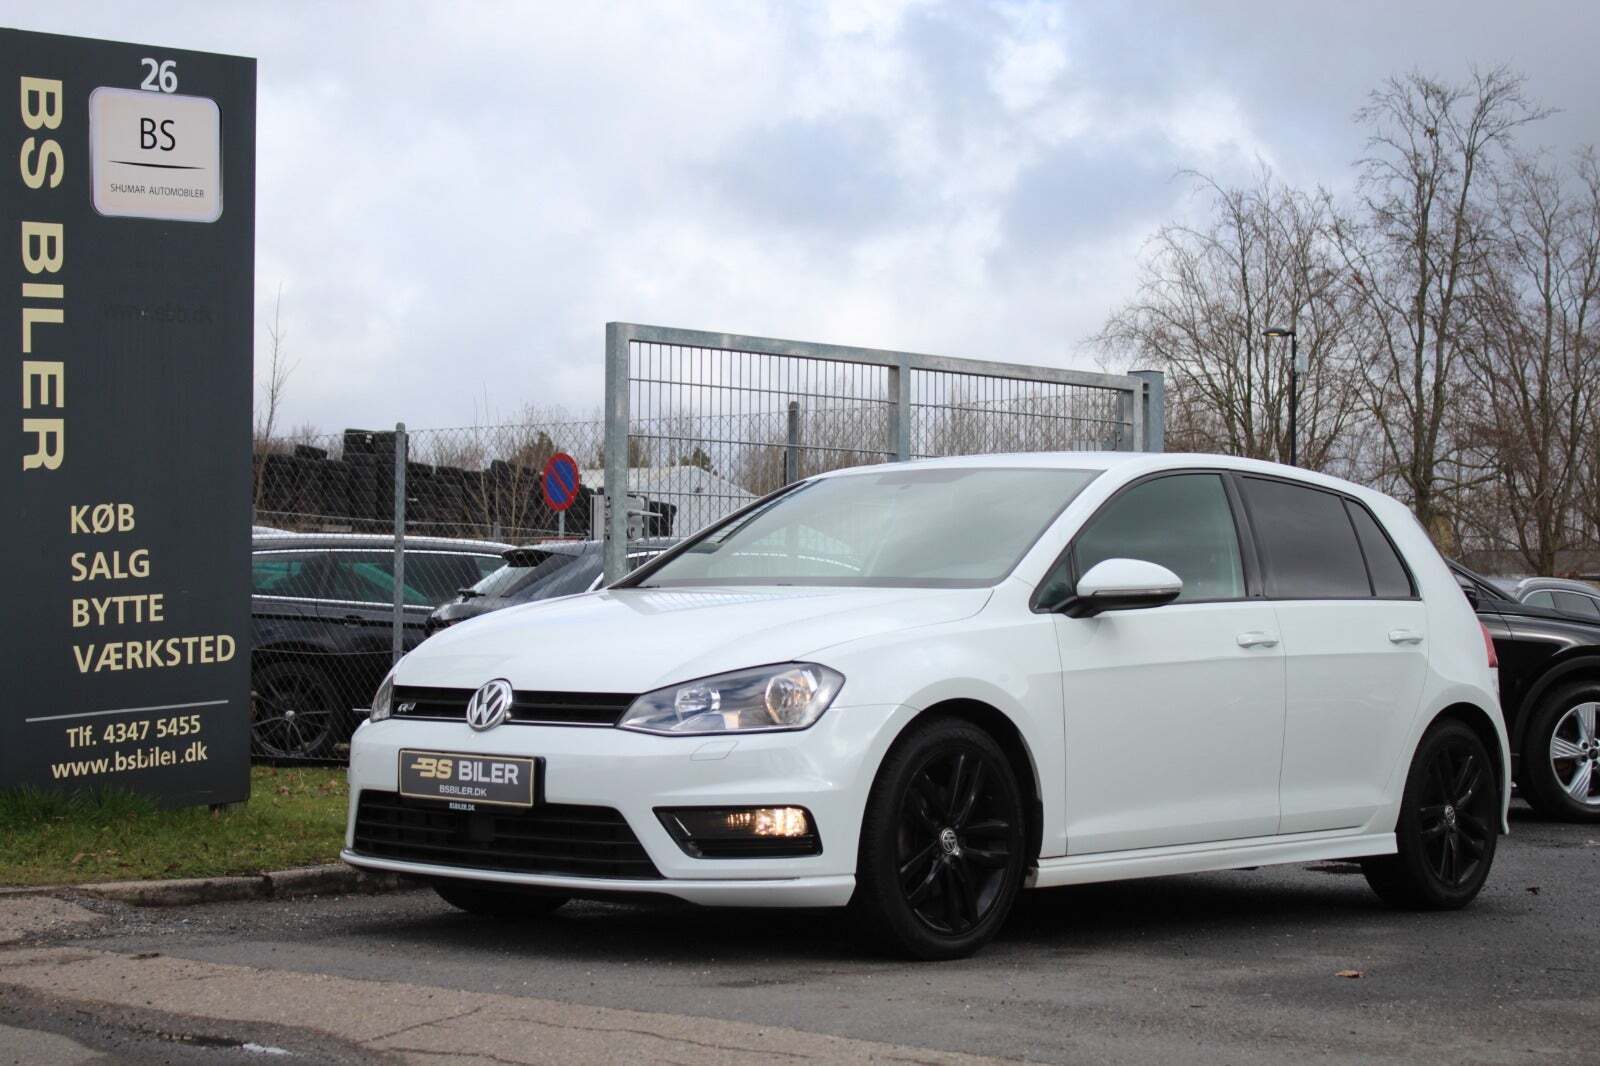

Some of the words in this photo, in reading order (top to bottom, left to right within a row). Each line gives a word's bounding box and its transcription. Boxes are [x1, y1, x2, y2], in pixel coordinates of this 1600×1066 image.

[140, 57, 178, 93] 26
[20, 76, 64, 190] BS
[140, 117, 176, 151] BS
[110, 183, 146, 195] SHUMAR
[149, 185, 205, 198] AUTOMOBILER
[21, 221, 64, 471] BILER
[70, 503, 135, 534] KØB
[71, 549, 150, 582] SALG
[72, 594, 164, 627] BYTTE
[73, 634, 236, 673] VÆRKSTED
[66, 725, 97, 748] Tlf.
[103, 720, 150, 744] 4347
[156, 714, 201, 738] 5455
[411, 757, 452, 779] BS
[458, 760, 519, 785] BILER
[439, 784, 487, 797] BSBILER.DK
